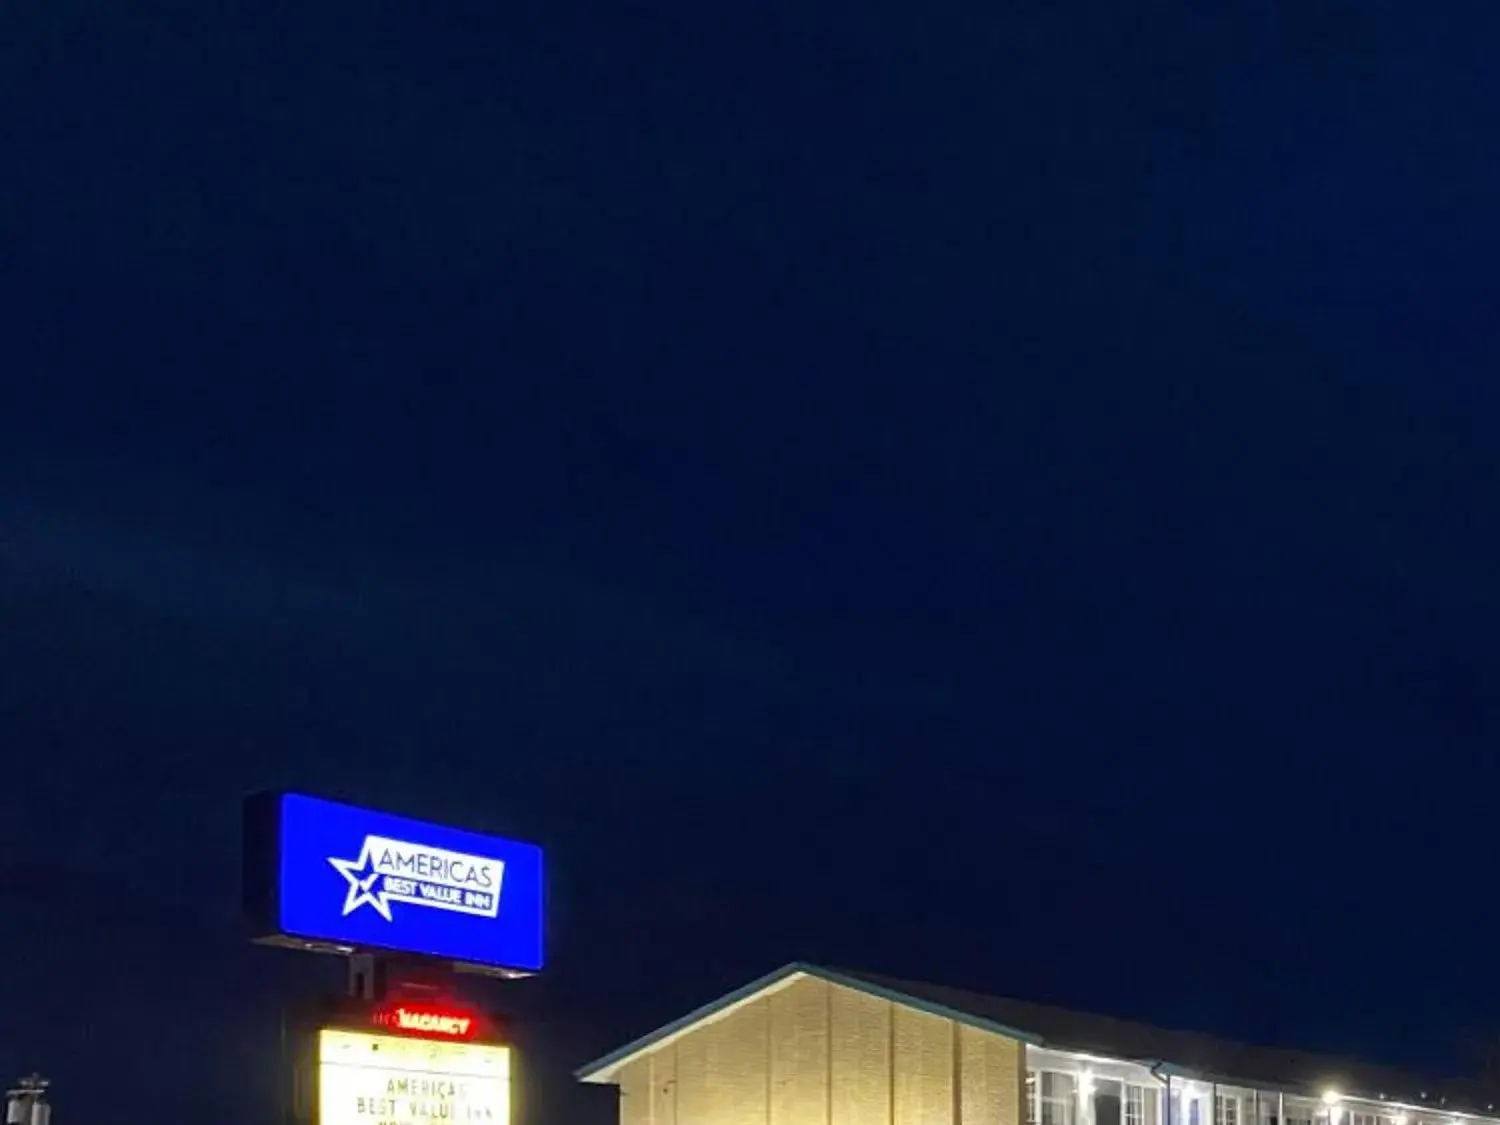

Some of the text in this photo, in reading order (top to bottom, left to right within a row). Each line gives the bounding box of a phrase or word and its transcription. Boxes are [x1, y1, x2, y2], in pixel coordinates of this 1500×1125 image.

[379, 848, 492, 888] AMERICAS
[383, 876, 417, 896] BEST
[419, 882, 462, 904] VALUE
[357, 1096, 396, 1116] BEST
